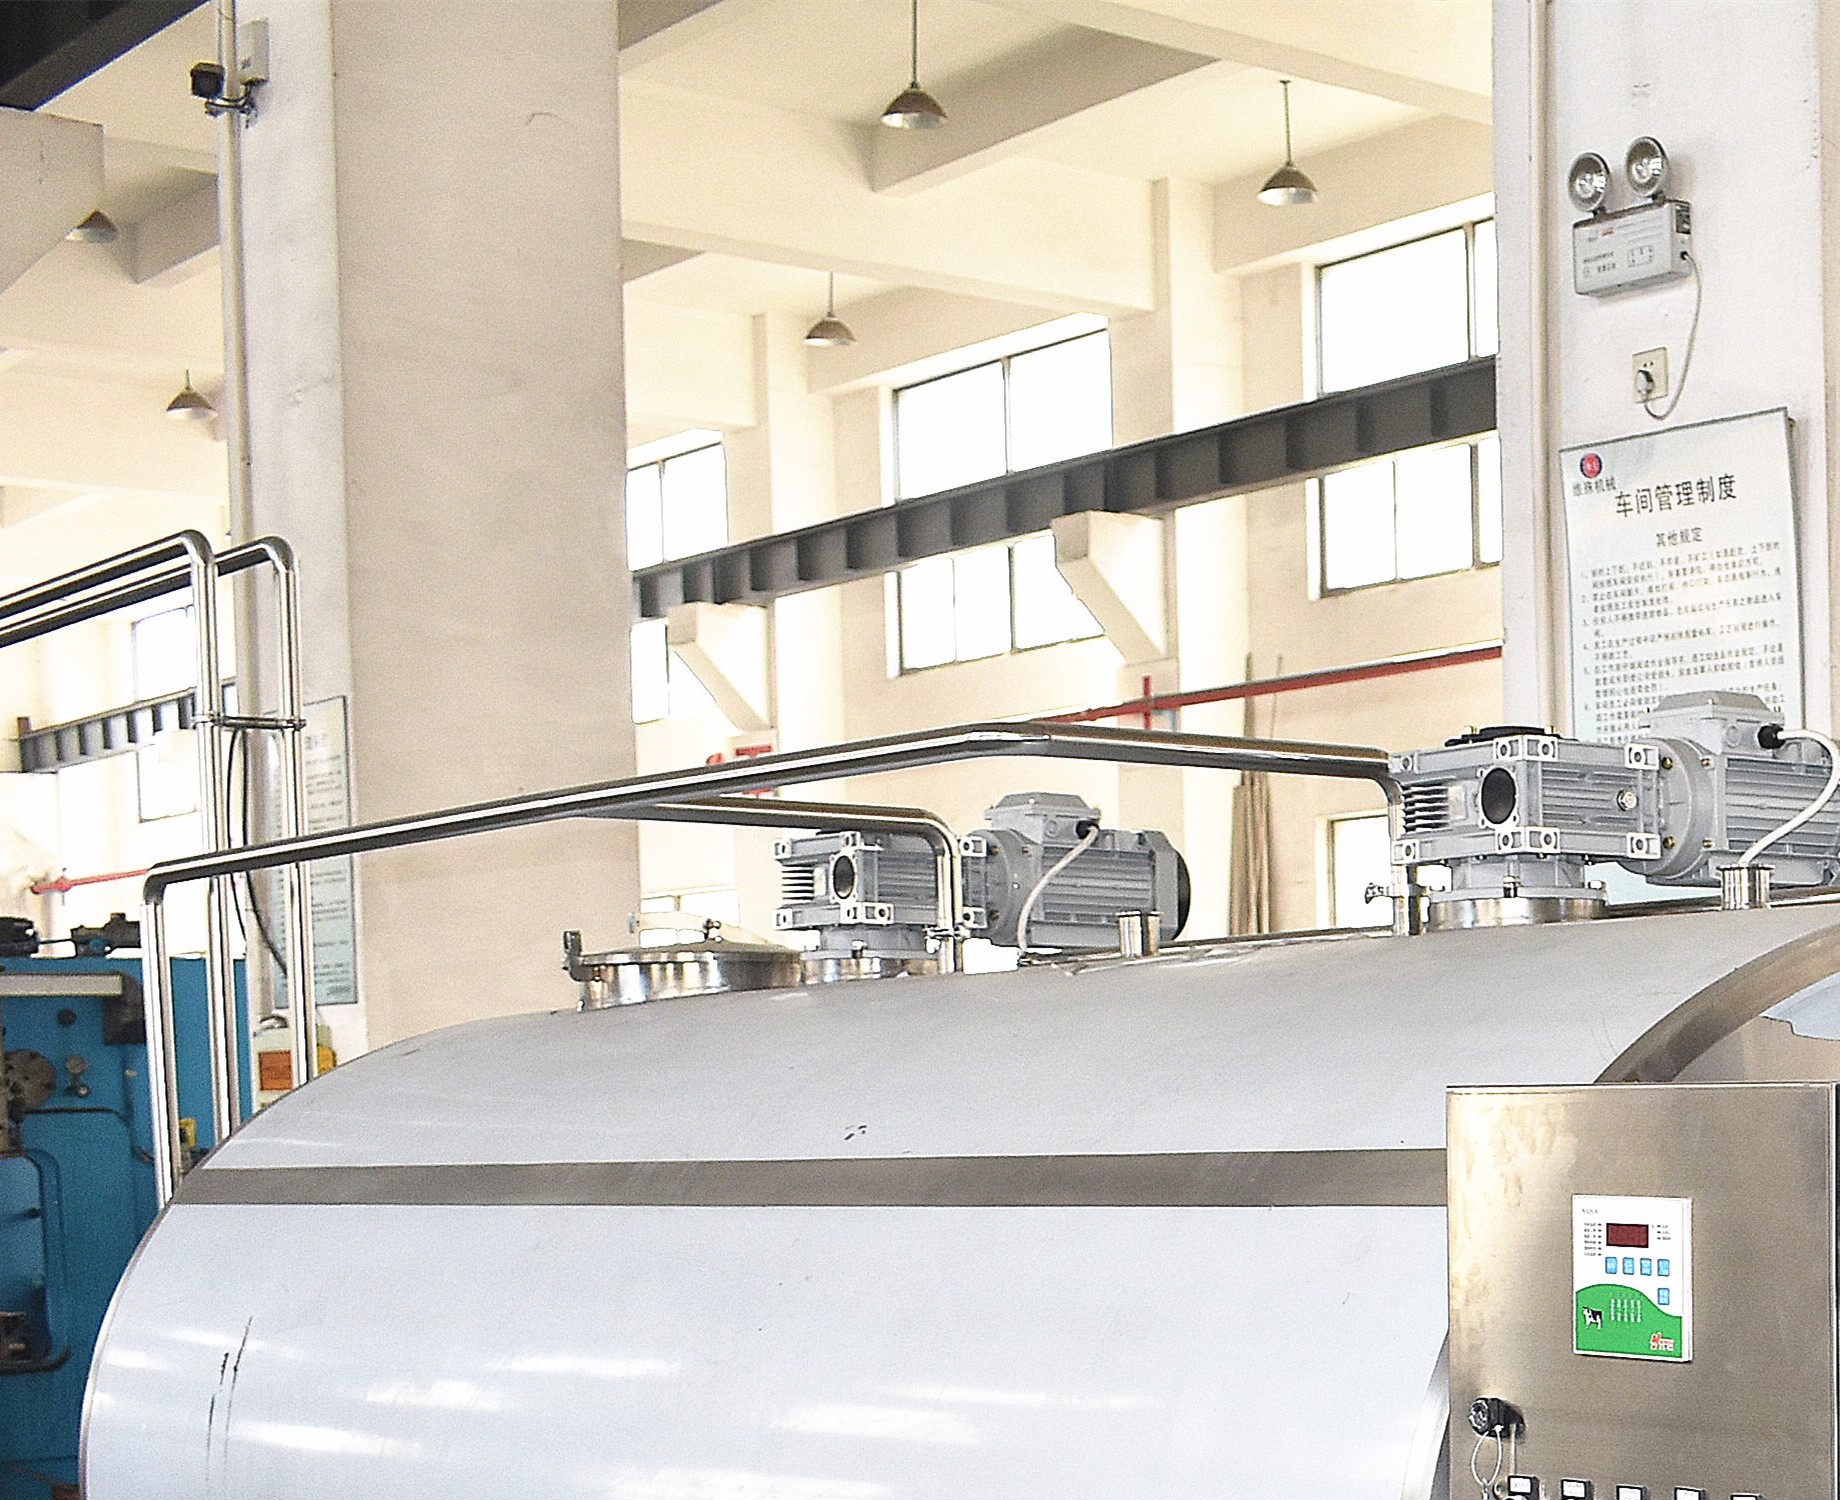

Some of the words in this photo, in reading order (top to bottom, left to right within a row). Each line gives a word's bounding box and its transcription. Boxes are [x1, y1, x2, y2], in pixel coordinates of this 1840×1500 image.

[1615, 474, 1737, 517] 车间管理制度
[1655, 527, 1703, 548] 其他规定
